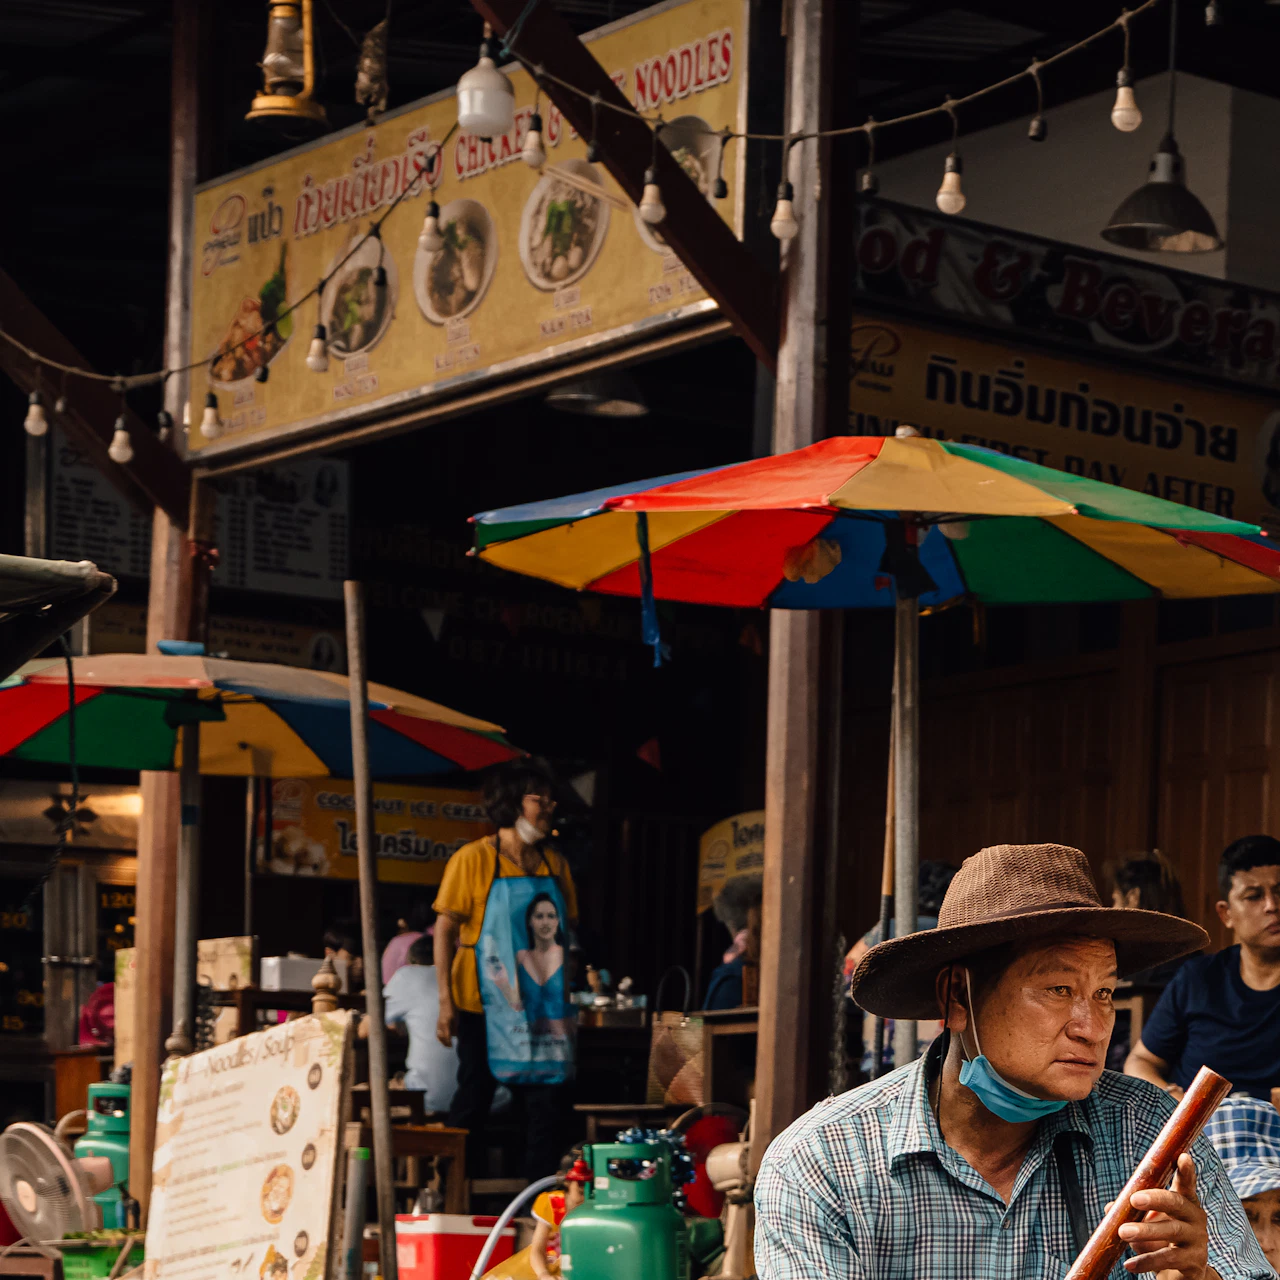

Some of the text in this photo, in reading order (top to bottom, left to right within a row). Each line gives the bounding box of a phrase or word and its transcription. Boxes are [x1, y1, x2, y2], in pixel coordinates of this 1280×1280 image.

[634, 32, 732, 109] NOODLES
[857, 227, 945, 285] od
[974, 241, 1030, 301] &
[925, 354, 1238, 462] กินอิ่มก่อนจ่าย
[441, 802, 490, 824] CREA
